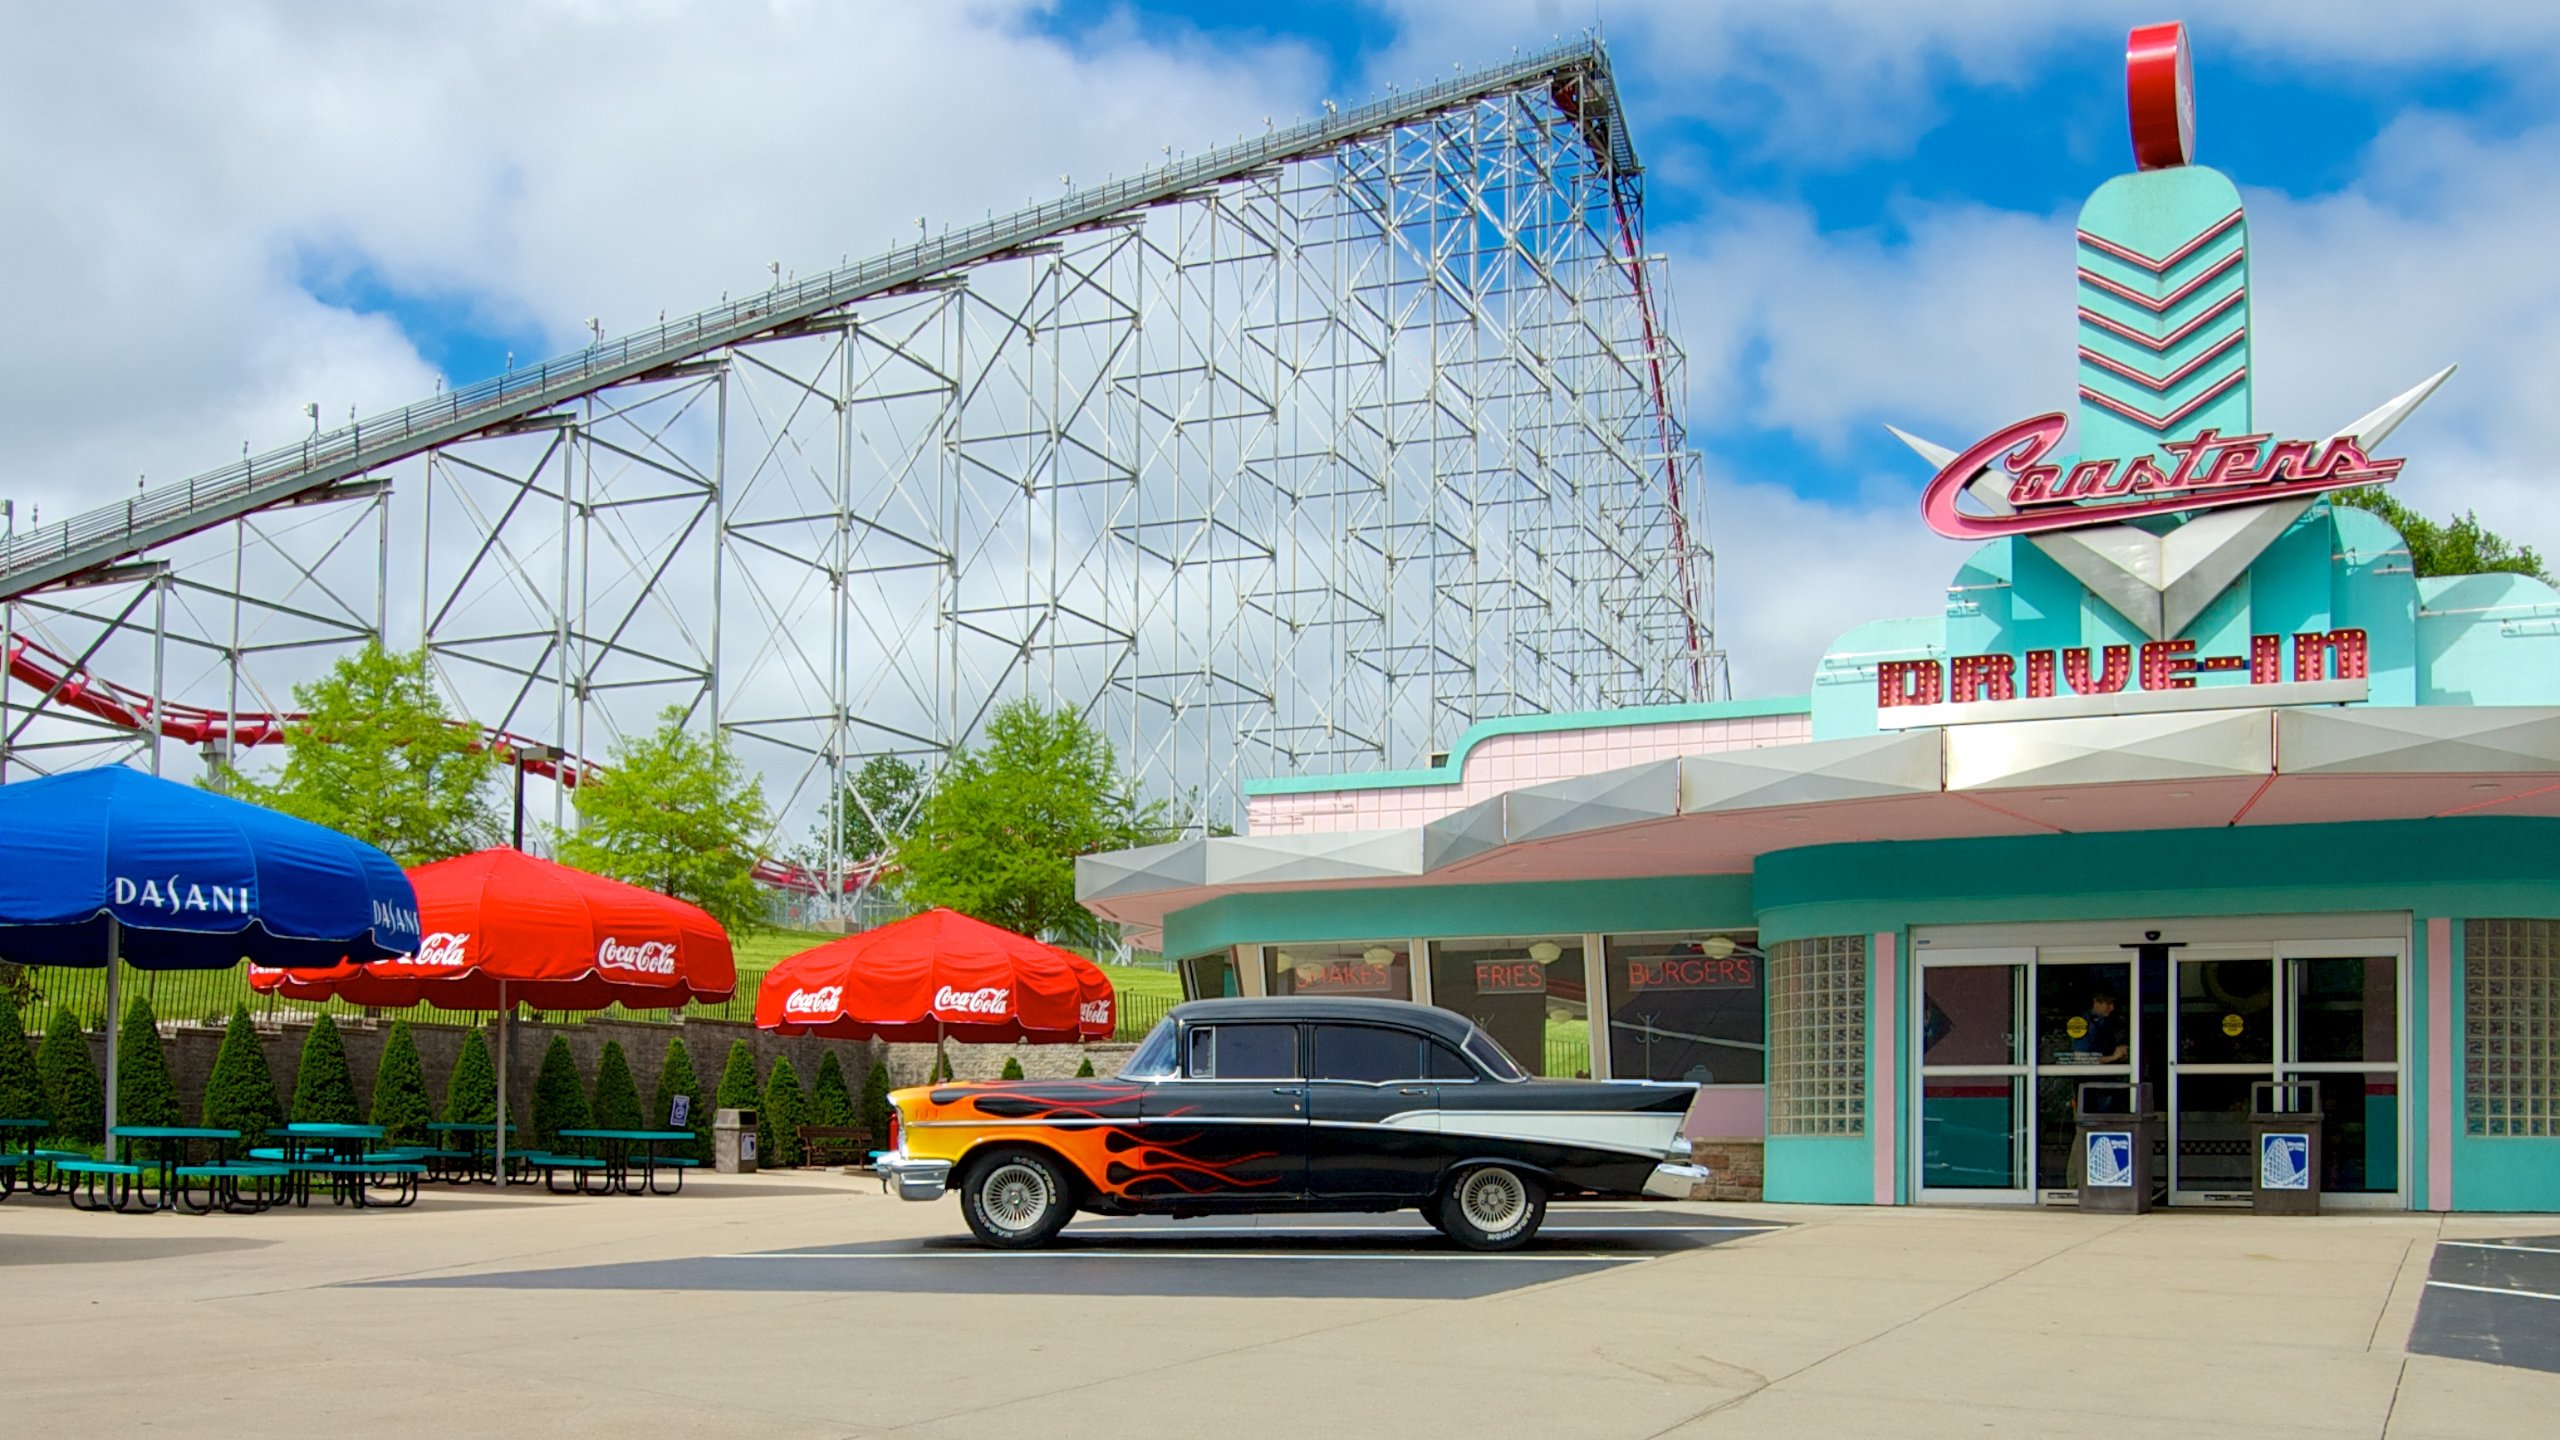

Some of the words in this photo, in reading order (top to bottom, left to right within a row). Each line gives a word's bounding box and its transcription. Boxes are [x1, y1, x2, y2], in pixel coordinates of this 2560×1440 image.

[1921, 411, 2406, 540] Coasters
[115, 874, 248, 915] DASANI
[373, 899, 420, 936] DASANI
[598, 937, 677, 974] Coca-Cola
[1294, 962, 1389, 989] SHAKES
[1476, 963, 1543, 988] FRIES
[1629, 959, 1752, 985] BURGERS
[786, 986, 843, 1013] Coca-Cola
[934, 985, 1010, 1014] Coca-Cola
